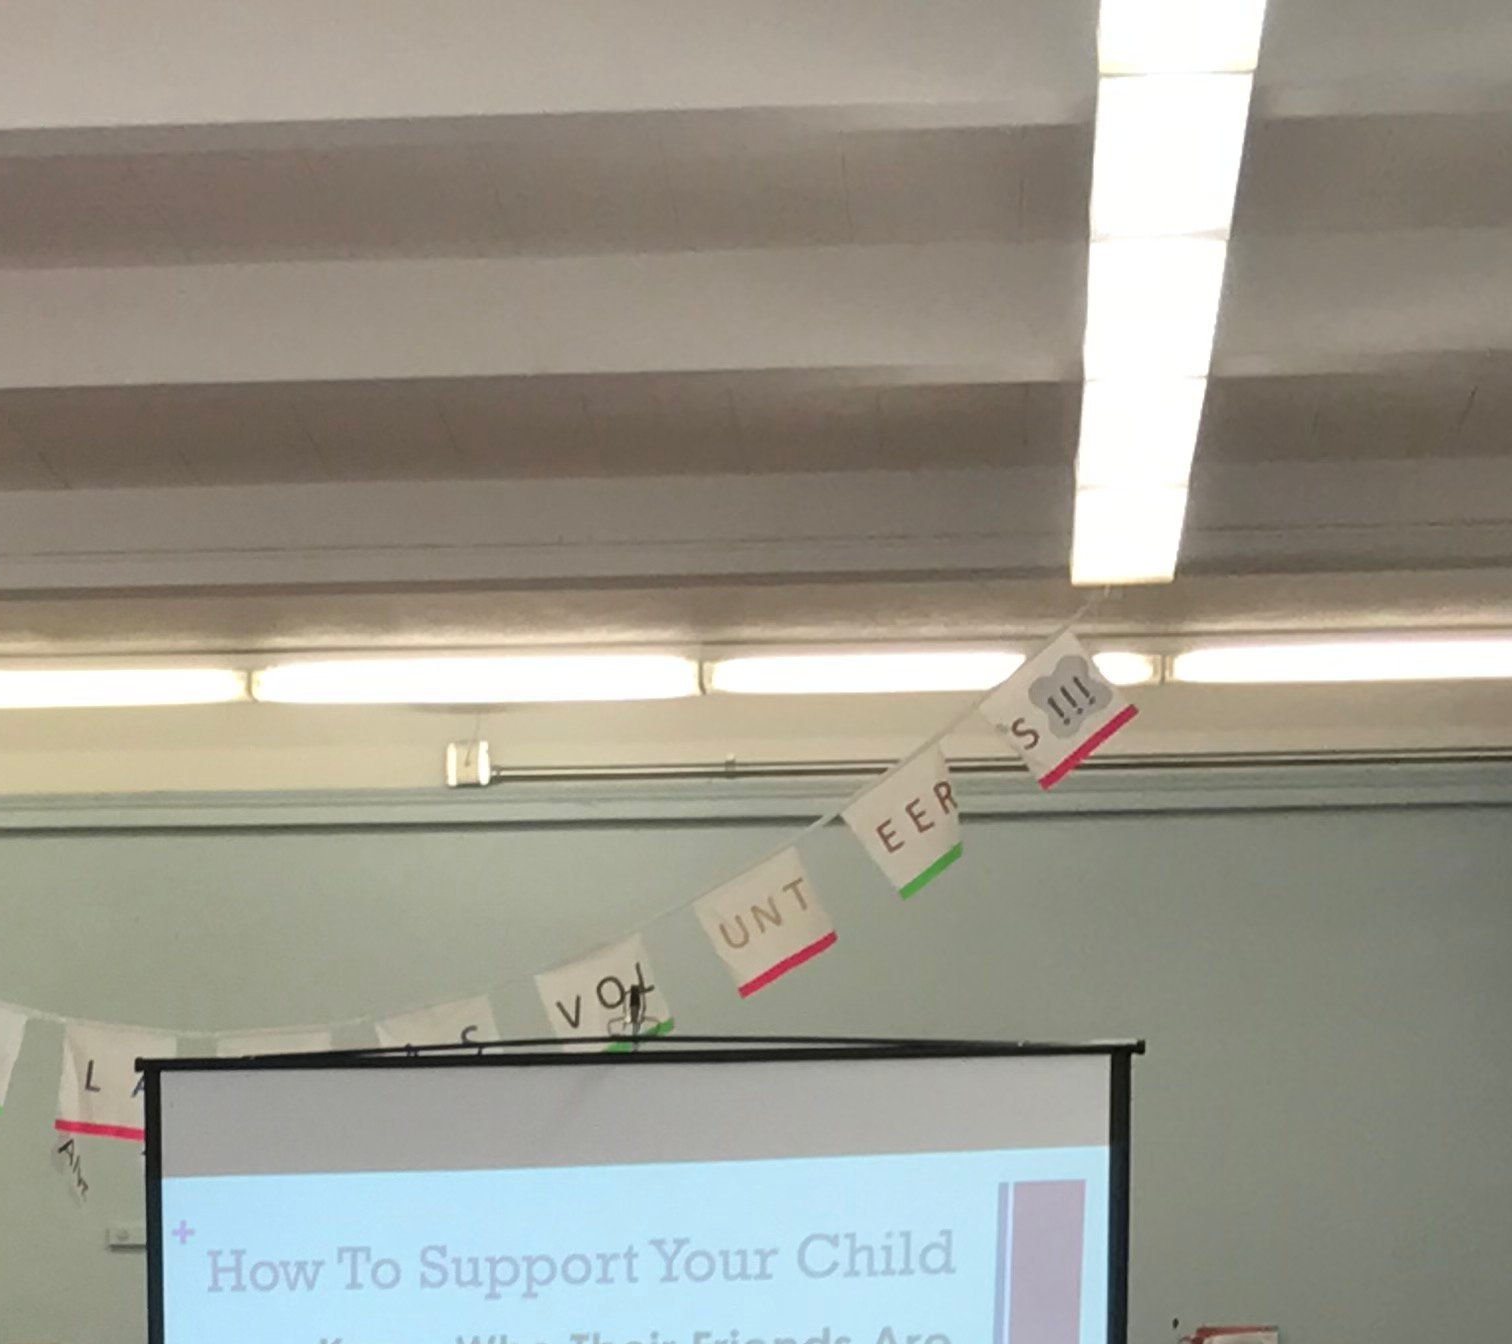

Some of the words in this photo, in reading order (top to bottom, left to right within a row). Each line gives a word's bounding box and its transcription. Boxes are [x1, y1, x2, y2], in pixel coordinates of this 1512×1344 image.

[206, 1248, 325, 1293] How
[336, 1245, 403, 1291] To
[419, 1243, 640, 1300] Support
[649, 1236, 779, 1284] Your
[796, 1229, 957, 1280] Child
